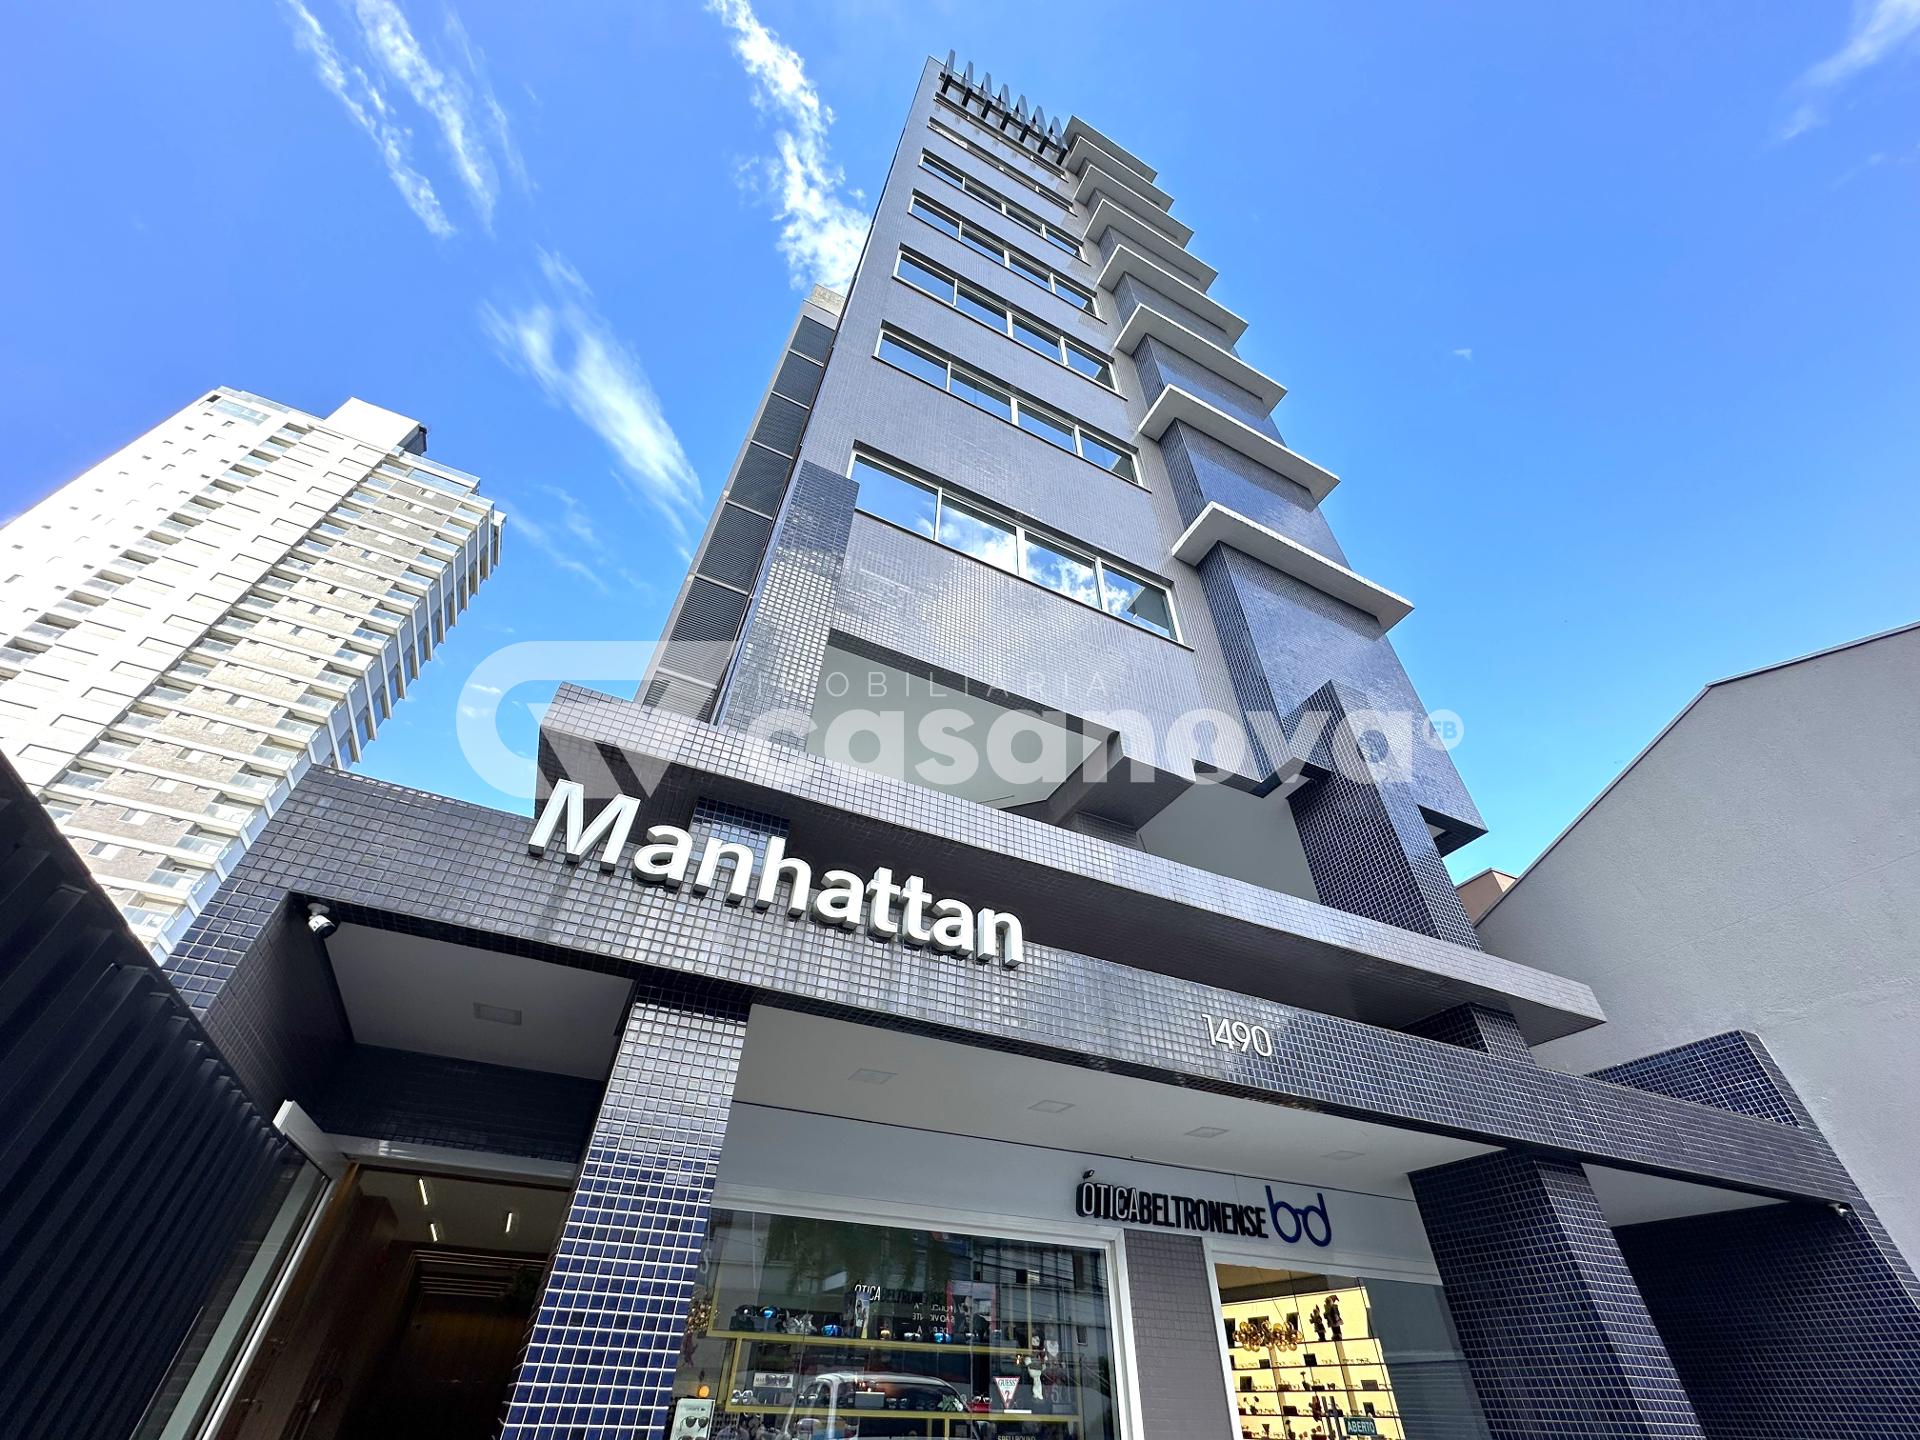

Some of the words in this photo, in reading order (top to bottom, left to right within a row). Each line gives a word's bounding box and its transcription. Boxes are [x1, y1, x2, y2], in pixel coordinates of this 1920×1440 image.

[528, 778, 1025, 969] Manhattan
[1201, 1013, 1273, 1057] 1490
[1347, 1420, 1375, 1433] ABERTO
